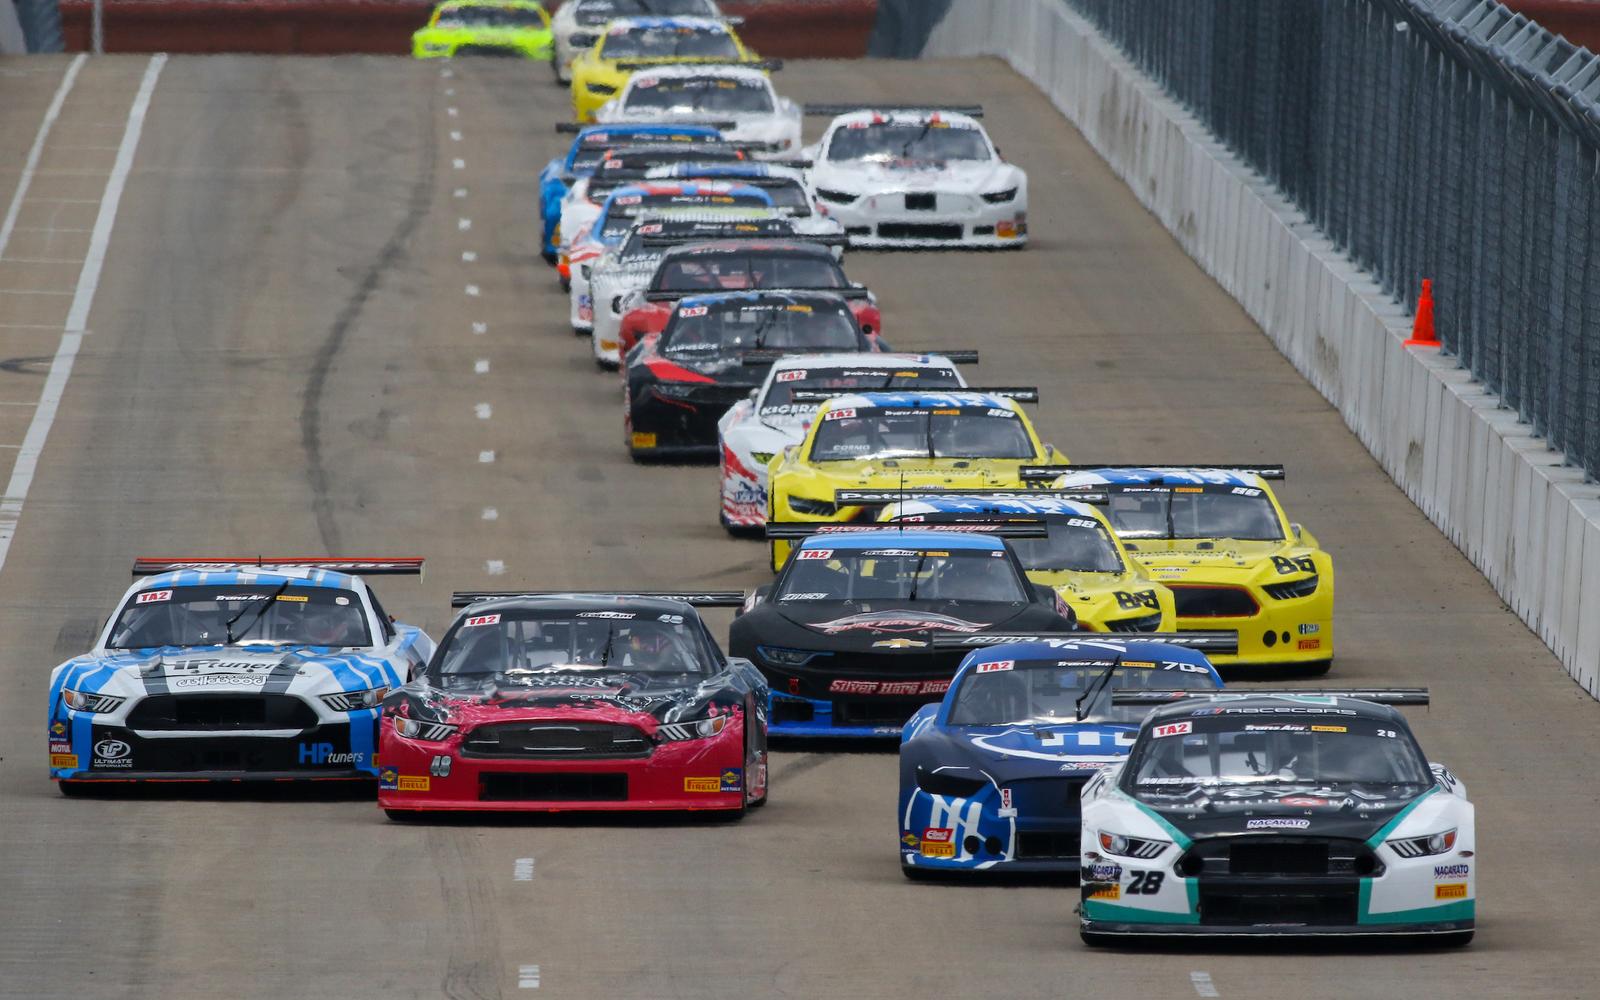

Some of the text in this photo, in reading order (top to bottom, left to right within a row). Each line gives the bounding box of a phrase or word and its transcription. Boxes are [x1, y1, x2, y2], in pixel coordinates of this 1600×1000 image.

[829, 408, 853, 418] TA2
[1067, 518, 1098, 529] 88
[803, 551, 830, 559] TA2
[1270, 555, 1317, 575] 86
[141, 591, 168, 602] TA2
[1112, 590, 1160, 610] 88
[469, 616, 497, 625] TA2
[981, 661, 1011, 672] TA2
[829, 680, 879, 693] Silver
[878, 681, 921, 694] Hare
[1158, 723, 1188, 735] TA2
[1376, 729, 1397, 738] 28
[50, 744, 71, 753] MOTUL
[400, 777, 428, 789] PIRELLI
[687, 779, 719, 791] PIRELLI
[1434, 864, 1469, 875] NACARATO
[1125, 870, 1165, 895] 28
[1437, 884, 1465, 896] PIRELLI
